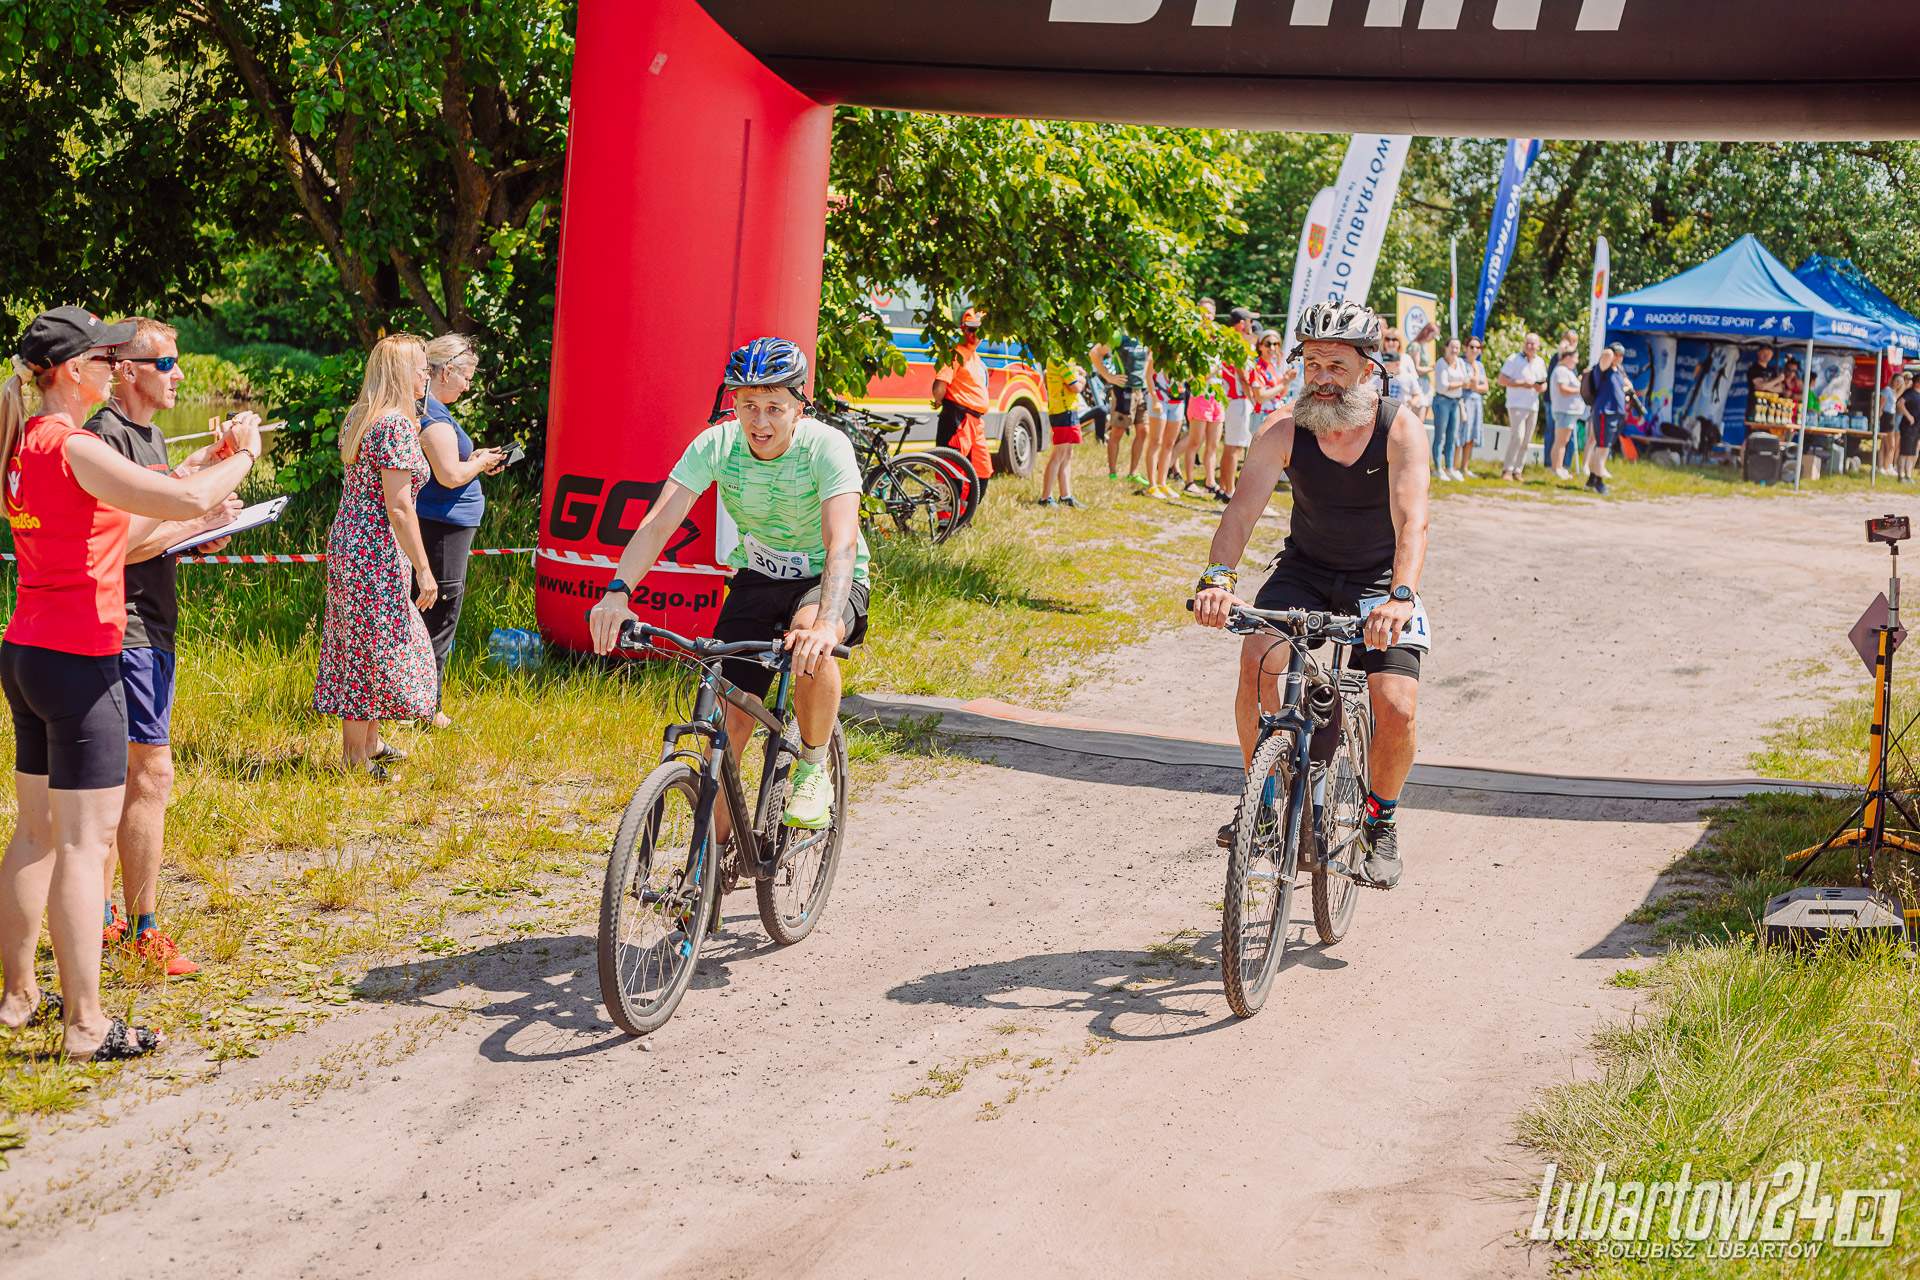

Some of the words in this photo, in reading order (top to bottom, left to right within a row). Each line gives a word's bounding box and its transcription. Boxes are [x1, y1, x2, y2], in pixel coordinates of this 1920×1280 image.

[1645, 312, 1687, 324] RADOŚĆ
[1688, 314, 1720, 325] PRZEZ
[1721, 316, 1755, 327] SPORT
[539, 575, 718, 612] www.ti2go.pl
